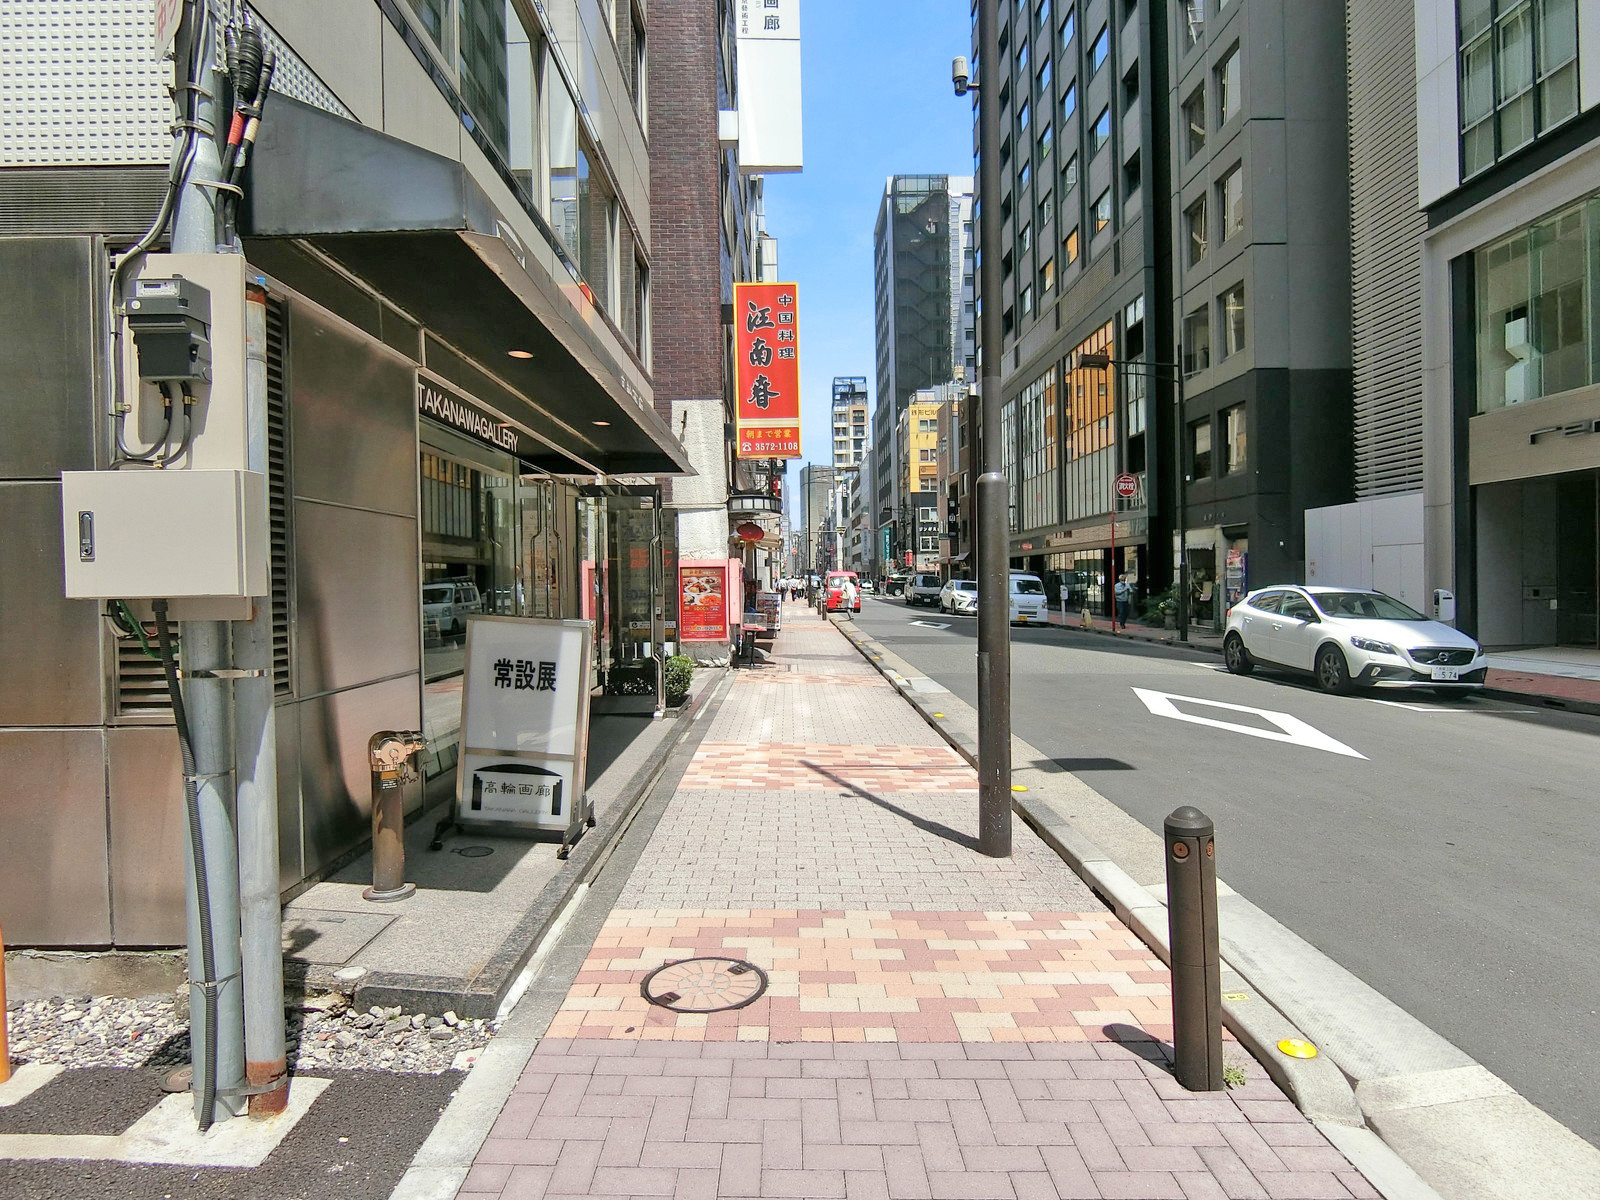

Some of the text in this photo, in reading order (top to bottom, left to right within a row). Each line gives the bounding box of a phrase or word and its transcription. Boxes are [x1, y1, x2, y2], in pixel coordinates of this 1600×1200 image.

[777, 294, 796, 359] 中国料理
[755, 442, 799, 451] 3572-1108
[493, 657, 557, 692] 常設展
[484, 781, 551, 798] 高輪画廊
